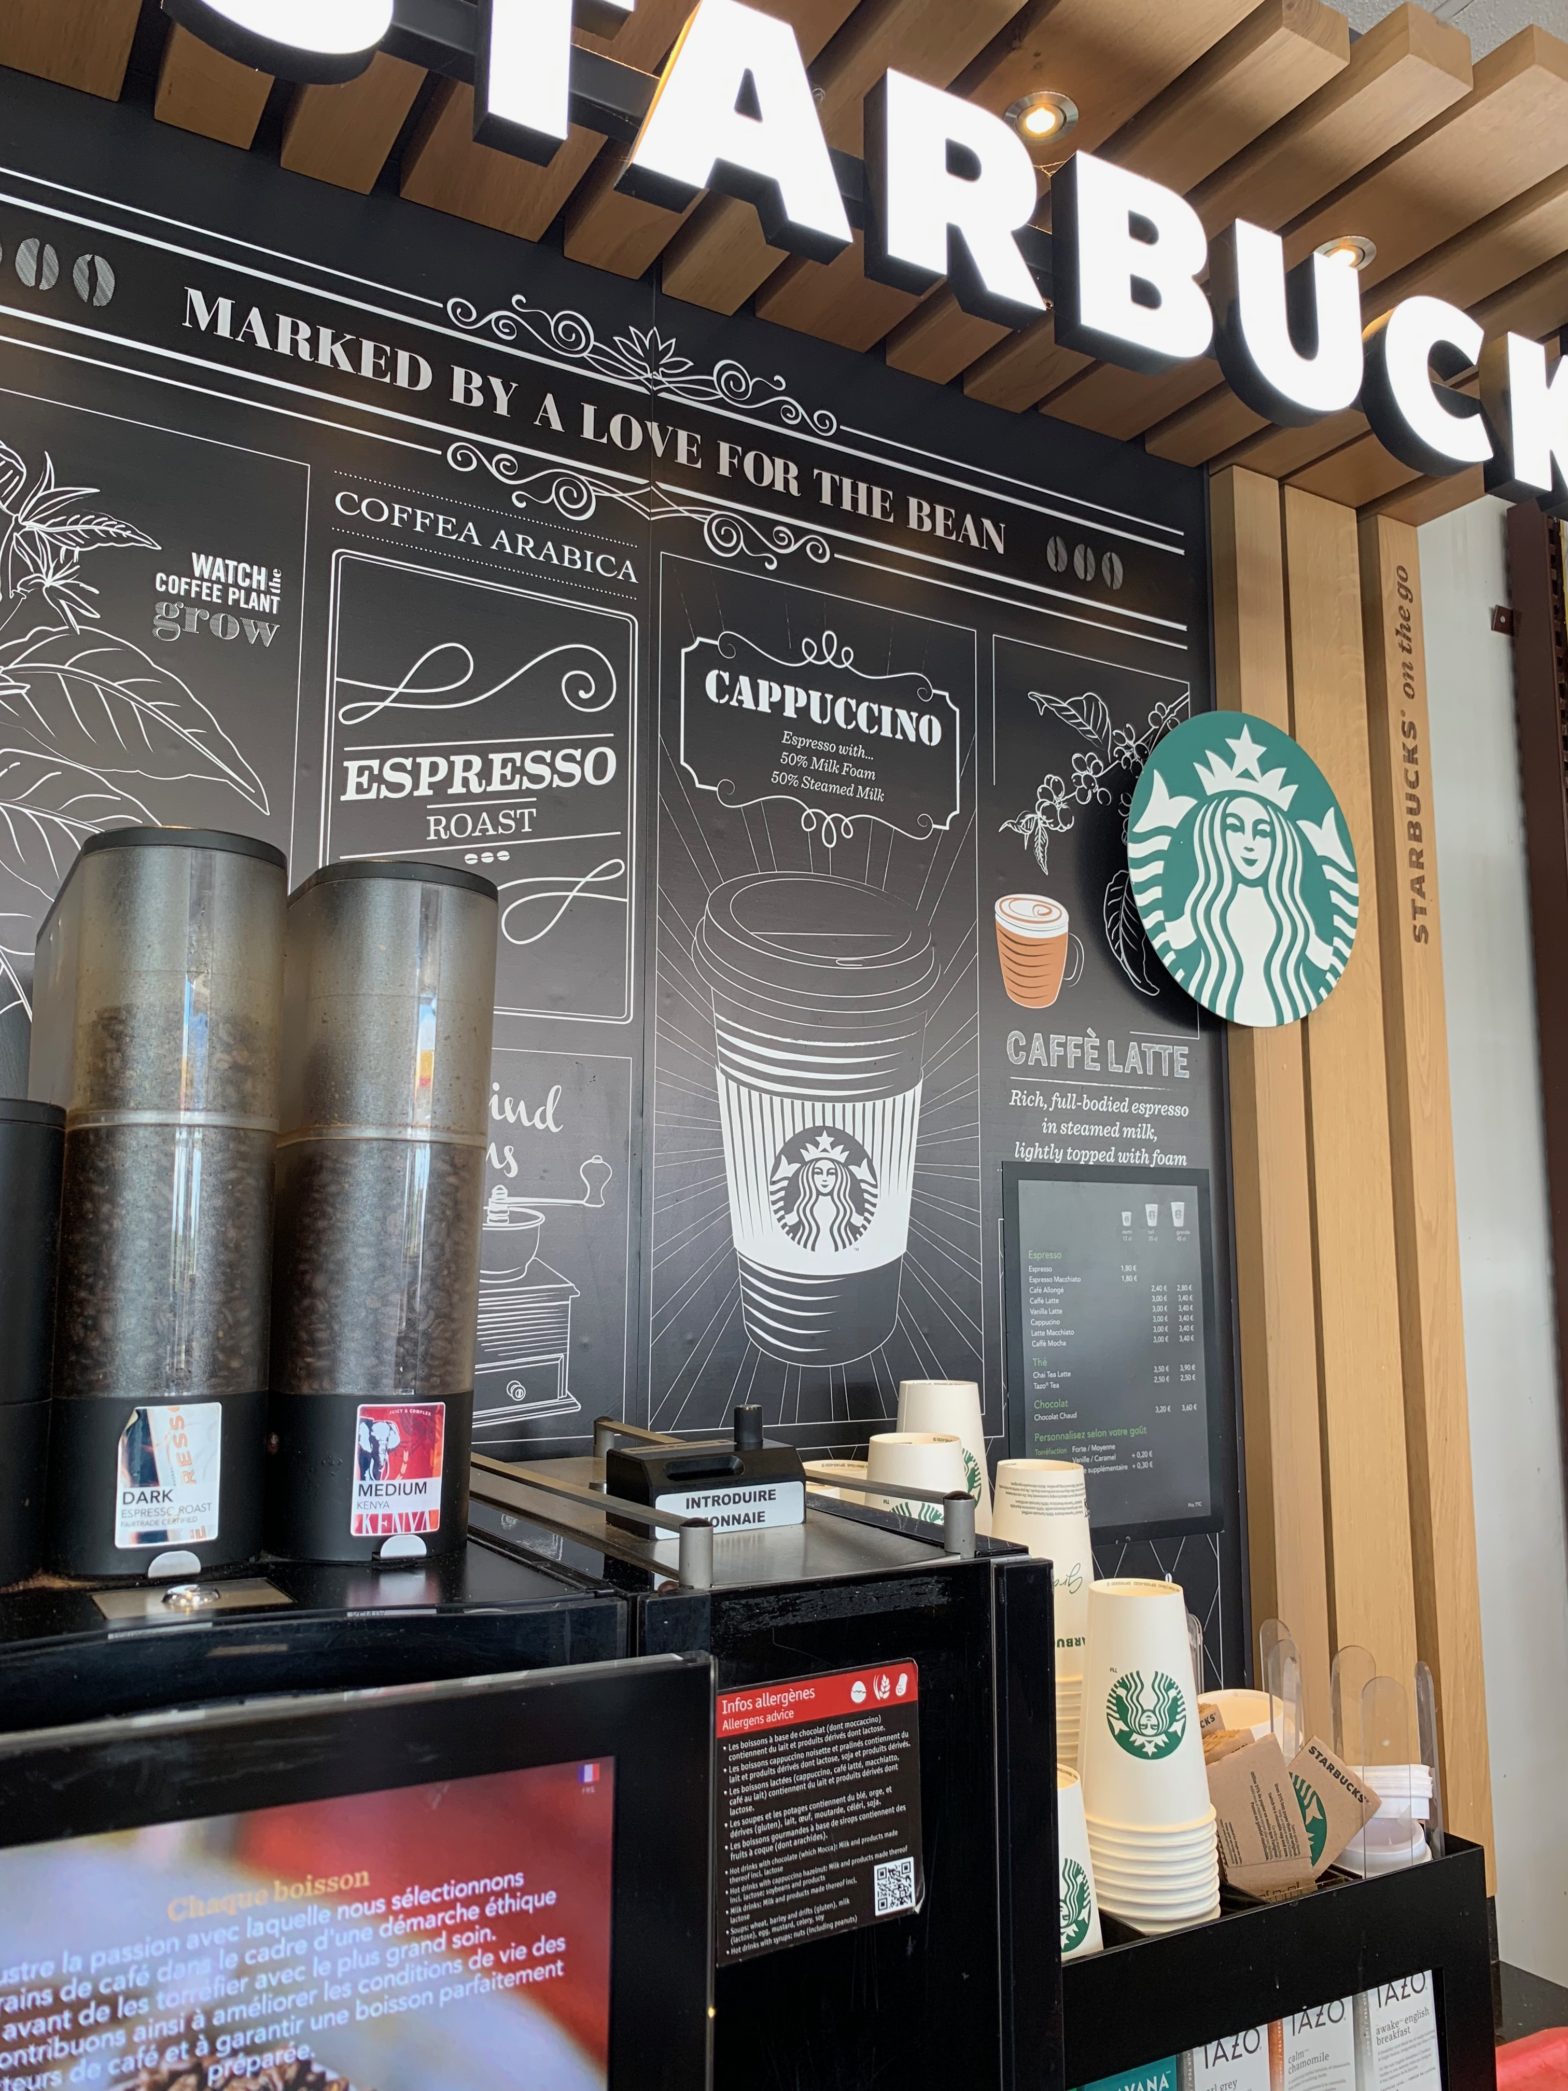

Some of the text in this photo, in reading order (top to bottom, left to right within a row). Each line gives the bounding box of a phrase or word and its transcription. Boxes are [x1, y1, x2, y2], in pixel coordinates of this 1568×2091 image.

[160, 0, 1568, 492] TARBUCK
[181, 286, 1007, 555] MARKED BY A LOVE FOR THE BEAN
[334, 490, 639, 584] COFFEA ARABICA
[191, 552, 282, 594] WATCH the
[1396, 565, 1418, 603] go
[155, 572, 280, 615] COFFEE PLANT
[151, 598, 280, 648] grow
[1395, 613, 1415, 656] the
[1403, 661, 1418, 700] on
[705, 669, 942, 746] CAPPUCCINO
[781, 731, 874, 761] Espresso with...
[340, 746, 617, 801] ESPRESSO
[780, 752, 876, 781] 50% Milk Foam
[771, 771, 885, 803] 50% Steamed Milk
[426, 807, 537, 841] ROAST
[1006, 1027, 1190, 1079] CAFFÈ LATTE
[1008, 1090, 1189, 1118] Rich, full-bodied espresso
[1042, 1118, 1158, 1143] in steamed milk,
[1014, 1142, 1188, 1168] lightly topped with foam
[1028, 1251, 1063, 1260] Espresso
[1028, 1265, 1052, 1274] Espresso
[1029, 1275, 1082, 1284] Espresso Macchiato
[1030, 1307, 1063, 1315] Vanilla Latte
[1031, 1328, 1075, 1337] Latte Macchiato
[1047, 1339, 1067, 1347] Mocha
[1033, 1371, 1045, 1379] Chai
[1057, 1370, 1071, 1378] Latte
[1034, 1400, 1069, 1409] Chocolat
[1034, 1412, 1078, 1422] Chocolat Chaud
[1034, 1430, 1085, 1443] Personnalisez
[1087, 1428, 1107, 1439] selon
[1109, 1428, 1128, 1437] votre
[122, 1489, 174, 1505] DARK
[358, 1481, 427, 1497] MEDIUM
[685, 1488, 777, 1510] INTRODUIRE
[178, 1503, 212, 1515] ROAST
[357, 1500, 390, 1510] KENYA
[722, 1688, 816, 1714] Infos allergènes
[722, 1709, 794, 1731] Allergens advice
[728, 1743, 739, 1751] Les
[740, 1738, 768, 1748] boissons
[774, 1734, 789, 1742] base
[790, 1731, 798, 1739] de
[799, 1726, 826, 1737] chocolat
[827, 1723, 843, 1733] (dont
[167, 1870, 370, 1922] Chaque boisson
[62, 1951, 83, 1973] la
[90, 1935, 180, 1974] passion
[186, 1925, 239, 1950] avec
[247, 1905, 331, 1939] laquelle
[337, 1898, 385, 1921] nous
[391, 1871, 524, 1910] sélectionnons
[59, 1977, 92, 2002] de
[99, 1965, 150, 1994] café
[156, 1958, 212, 1983] dans
[219, 1949, 238, 1971] le
[244, 1936, 308, 1965] cadre
[313, 1927, 373, 1952] d'une
[379, 1902, 480, 1938] démarche
[485, 1890, 557, 1918] éthique
[2, 1926, 497, 2042] avant de les torréfier avec le plus grand soin.
[132, 2016, 186, 2043] ainsi
[191, 2006, 205, 2030] à
[212, 1989, 317, 2026] améliorer
[323, 1980, 352, 2002] les
[358, 1957, 462, 1994] conditions
[468, 1948, 494, 1971] de
[499, 1942, 527, 1964] vie
[532, 1935, 566, 1957] des
[70, 2058, 101, 2083] de
[108, 2046, 158, 2075] café
[165, 2041, 189, 2063] et
[195, 2035, 209, 2057] à
[215, 2014, 303, 2058] garantir
[310, 2007, 348, 2031] une
[355, 1990, 433, 2021] boisson
[439, 1960, 564, 2007] parfaitement
[1404, 2007, 1430, 2024] english
[1376, 2026, 1411, 2046] breakfast
[208, 2041, 315, 2083] préparée.
[1287, 2053, 1330, 2075] chamomile
